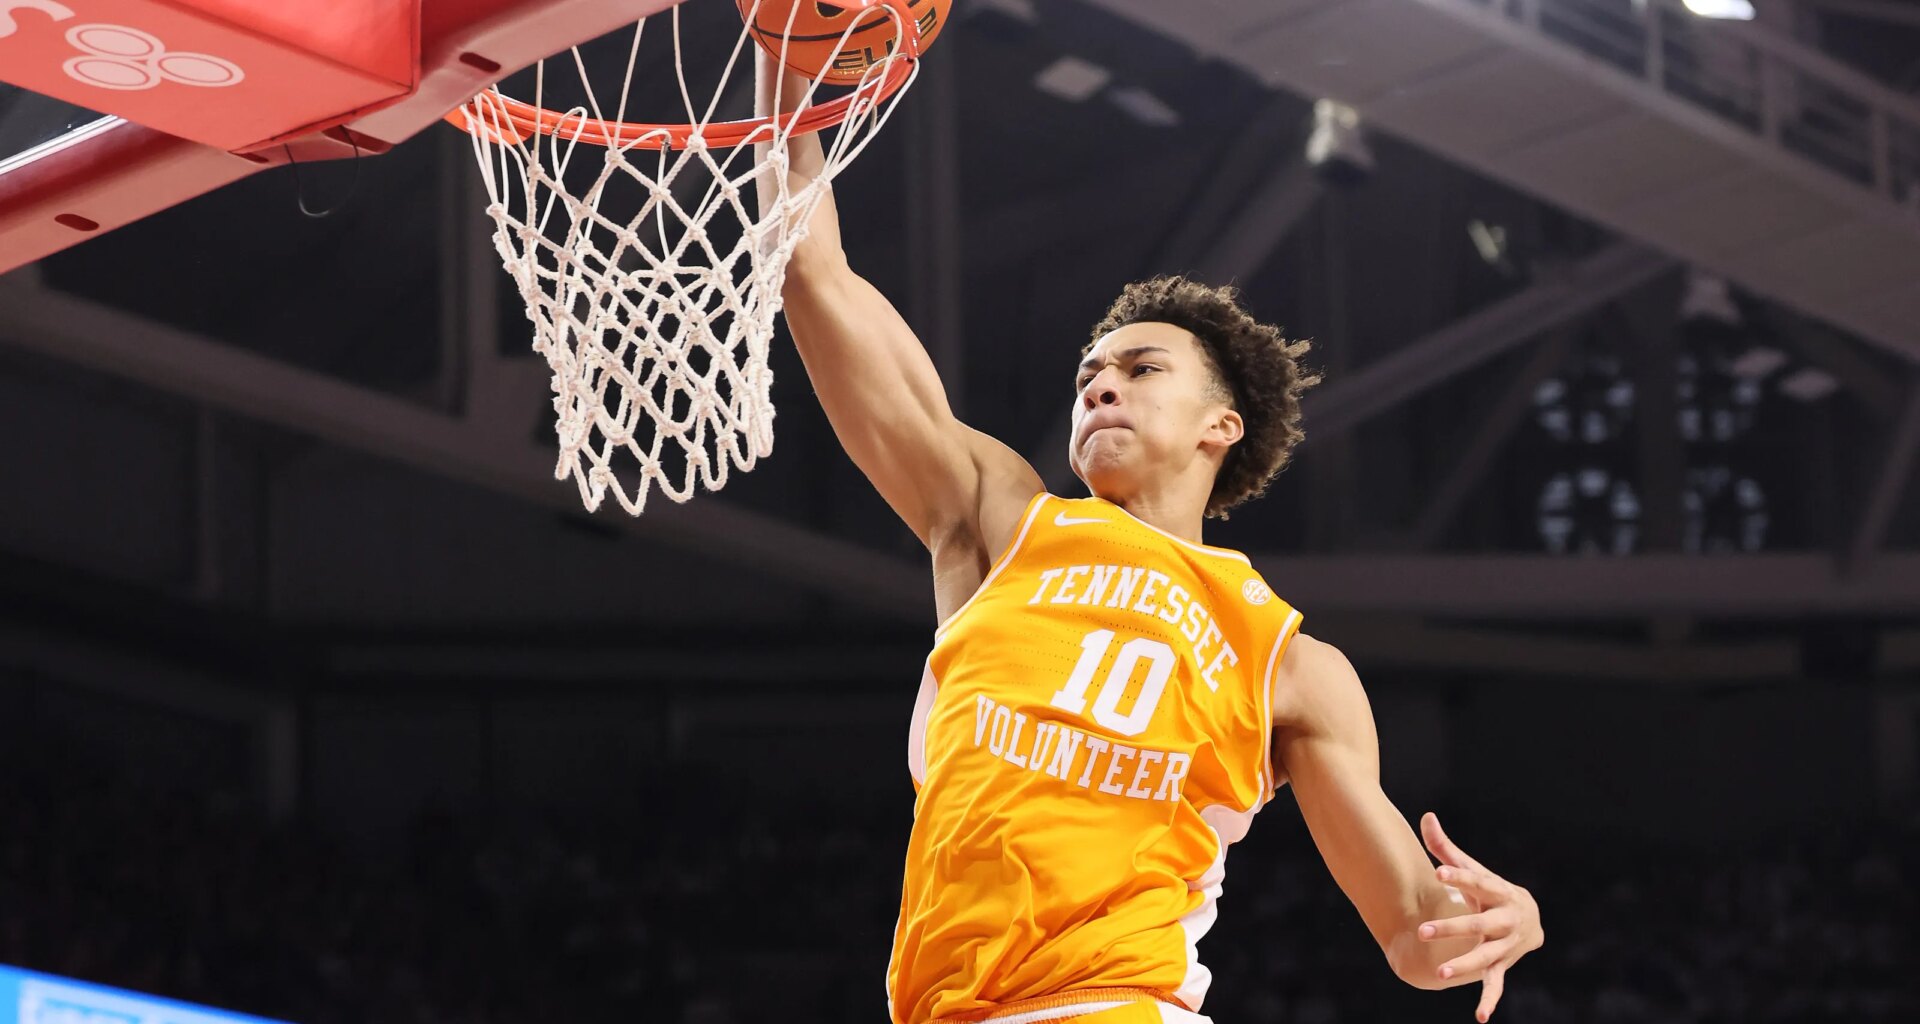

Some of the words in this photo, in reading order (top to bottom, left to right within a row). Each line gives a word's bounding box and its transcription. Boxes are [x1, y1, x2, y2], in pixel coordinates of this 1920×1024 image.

[1028, 566, 1238, 692] TENNESSEE
[1244, 581, 1269, 604] SEC
[1051, 629, 1176, 736] 10
